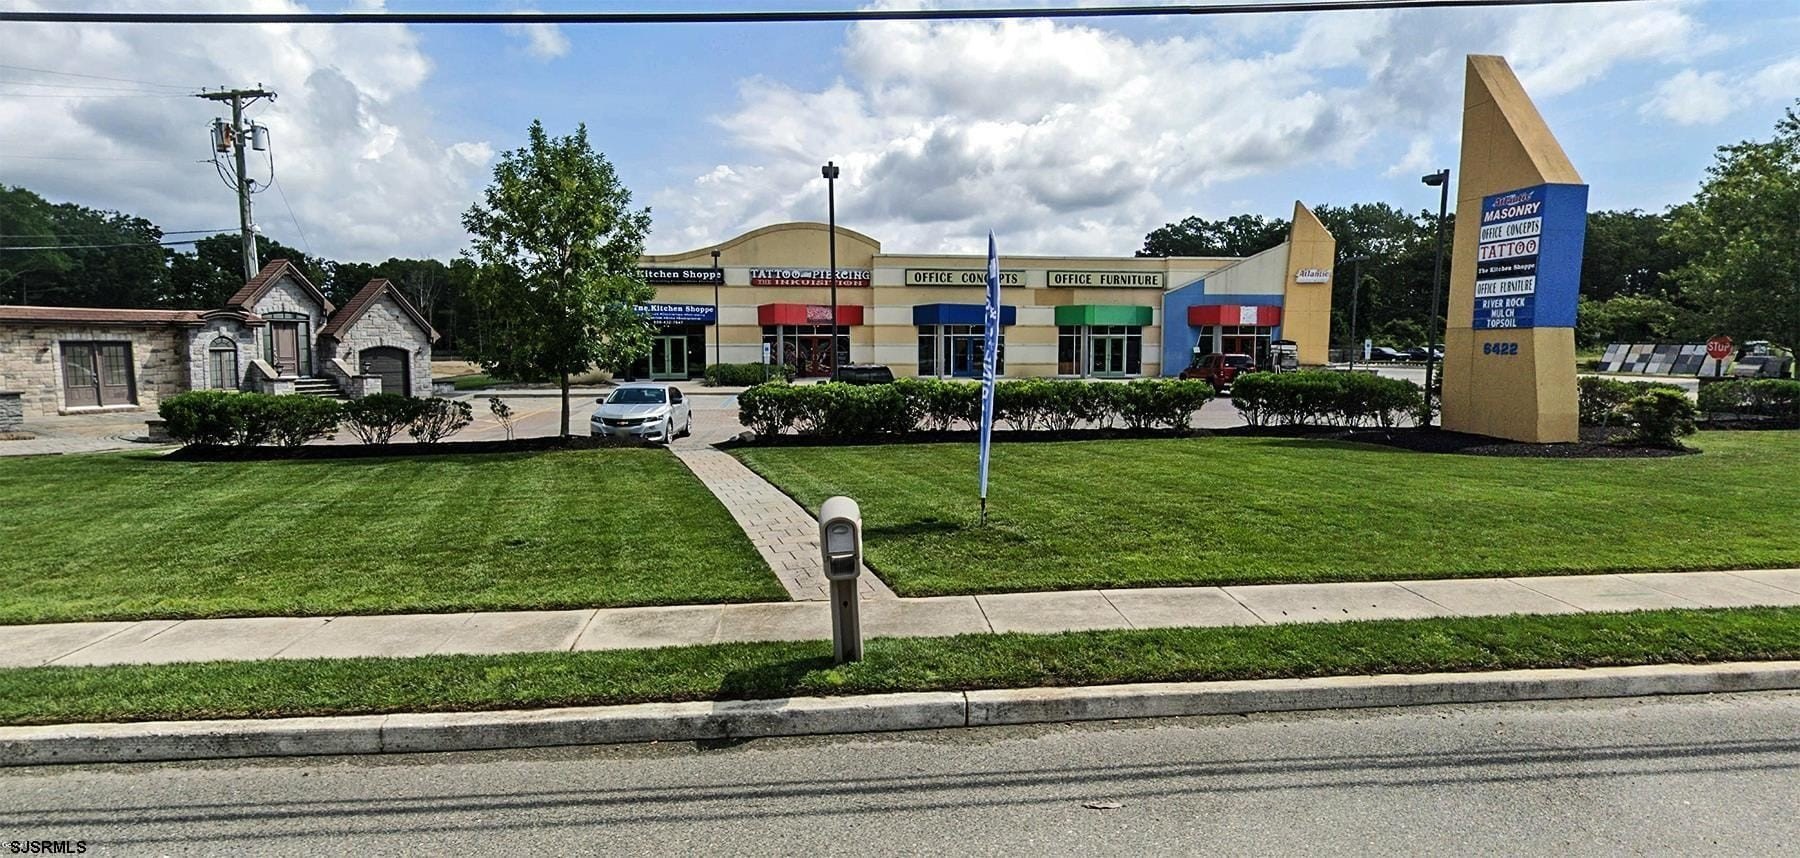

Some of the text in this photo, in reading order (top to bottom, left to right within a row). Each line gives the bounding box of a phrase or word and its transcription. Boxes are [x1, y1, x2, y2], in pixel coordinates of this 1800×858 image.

[1483, 201, 1541, 222] MASONRY
[1481, 219, 1540, 240] OFFICE CONCEPTS
[1480, 239, 1537, 260] TATTOO
[637, 269, 679, 279] Kitchen
[682, 270, 721, 281] Shoppe
[751, 268, 800, 279] TATTOO
[812, 270, 870, 280] PIERCING
[1490, 265, 1512, 273] Kitchen
[914, 271, 1019, 285] OFFICE CONCPTS
[1054, 273, 1159, 286] OFFICE FURNITURE
[1477, 278, 1533, 295] OFFICE FURNITURE
[651, 303, 683, 313] Kitchen
[685, 305, 714, 315] Shoppe
[1482, 297, 1526, 309] RIVER ROCK
[1491, 308, 1515, 318] MULCH
[1487, 318, 1517, 328] TOPSOIL
[1483, 342, 1518, 355] 6422
[1708, 341, 1730, 352] STOP
